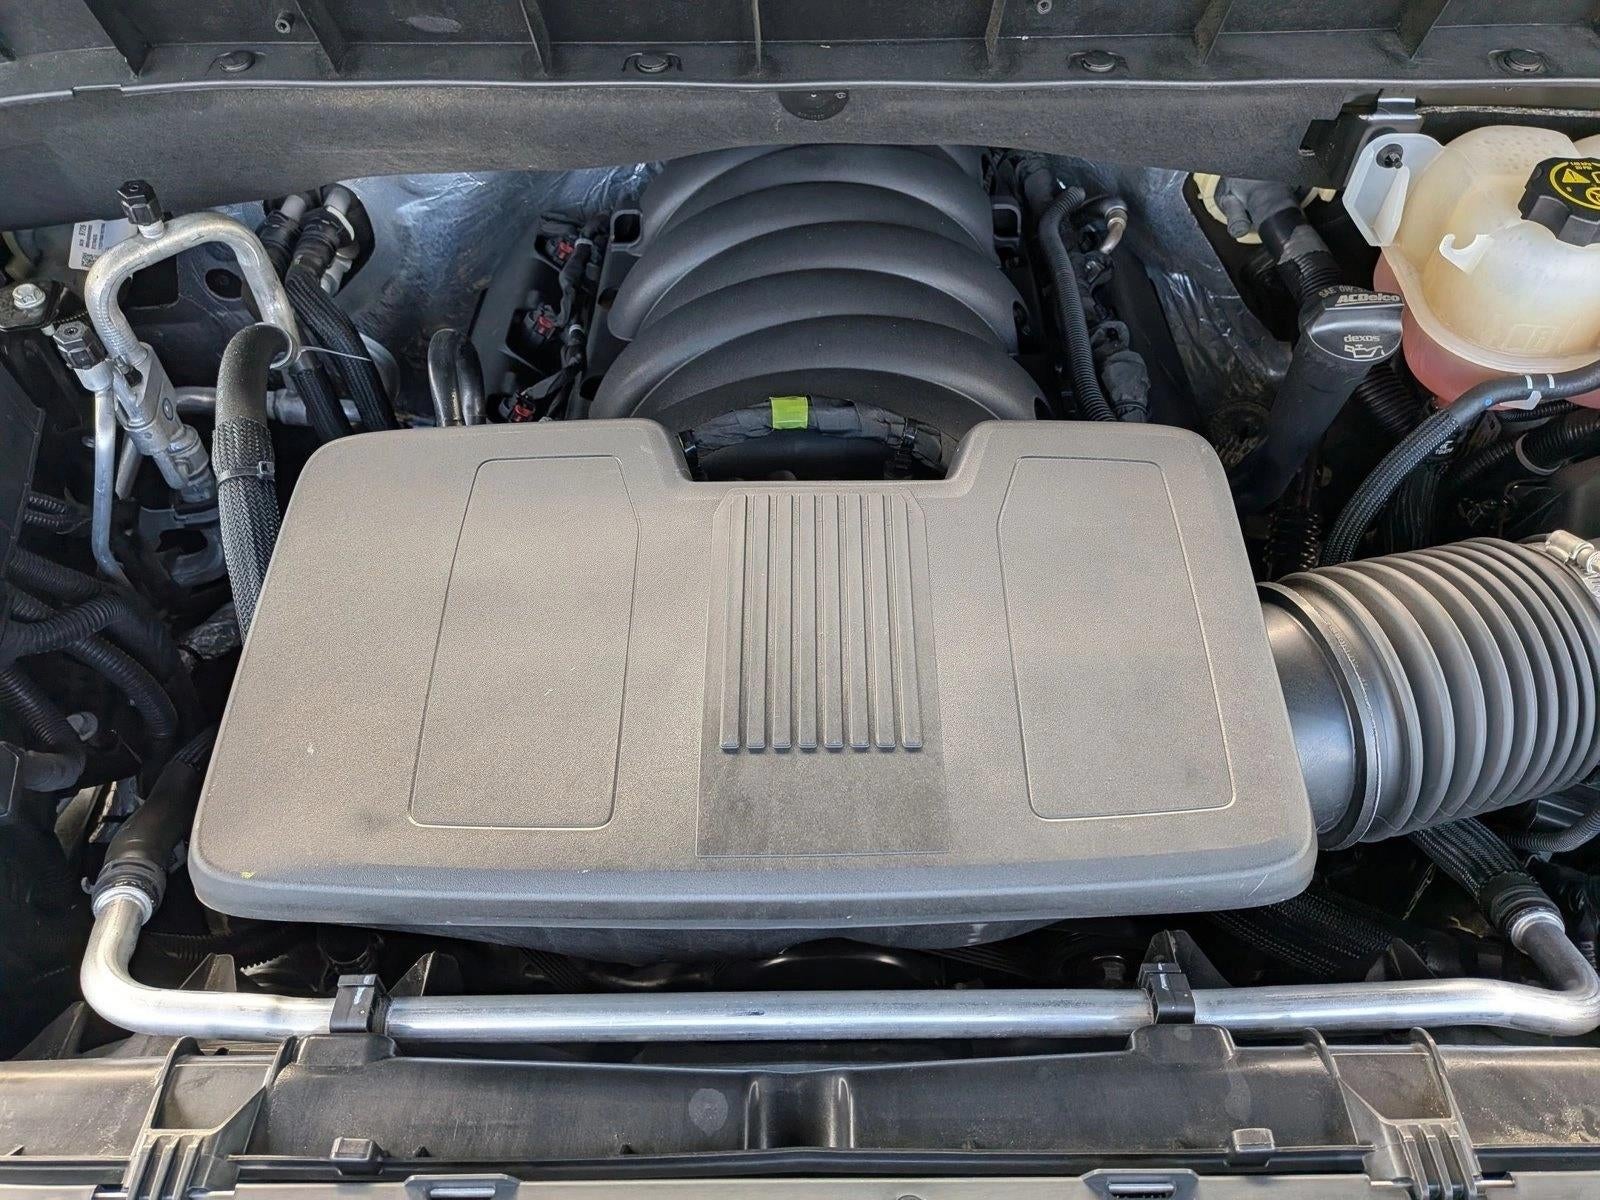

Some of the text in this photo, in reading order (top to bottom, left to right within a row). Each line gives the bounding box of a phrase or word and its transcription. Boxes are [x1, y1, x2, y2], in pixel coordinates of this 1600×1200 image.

[1318, 287, 1337, 298] SAE
[1336, 293, 1401, 304] ACDelco
[1343, 334, 1380, 343] dexos
